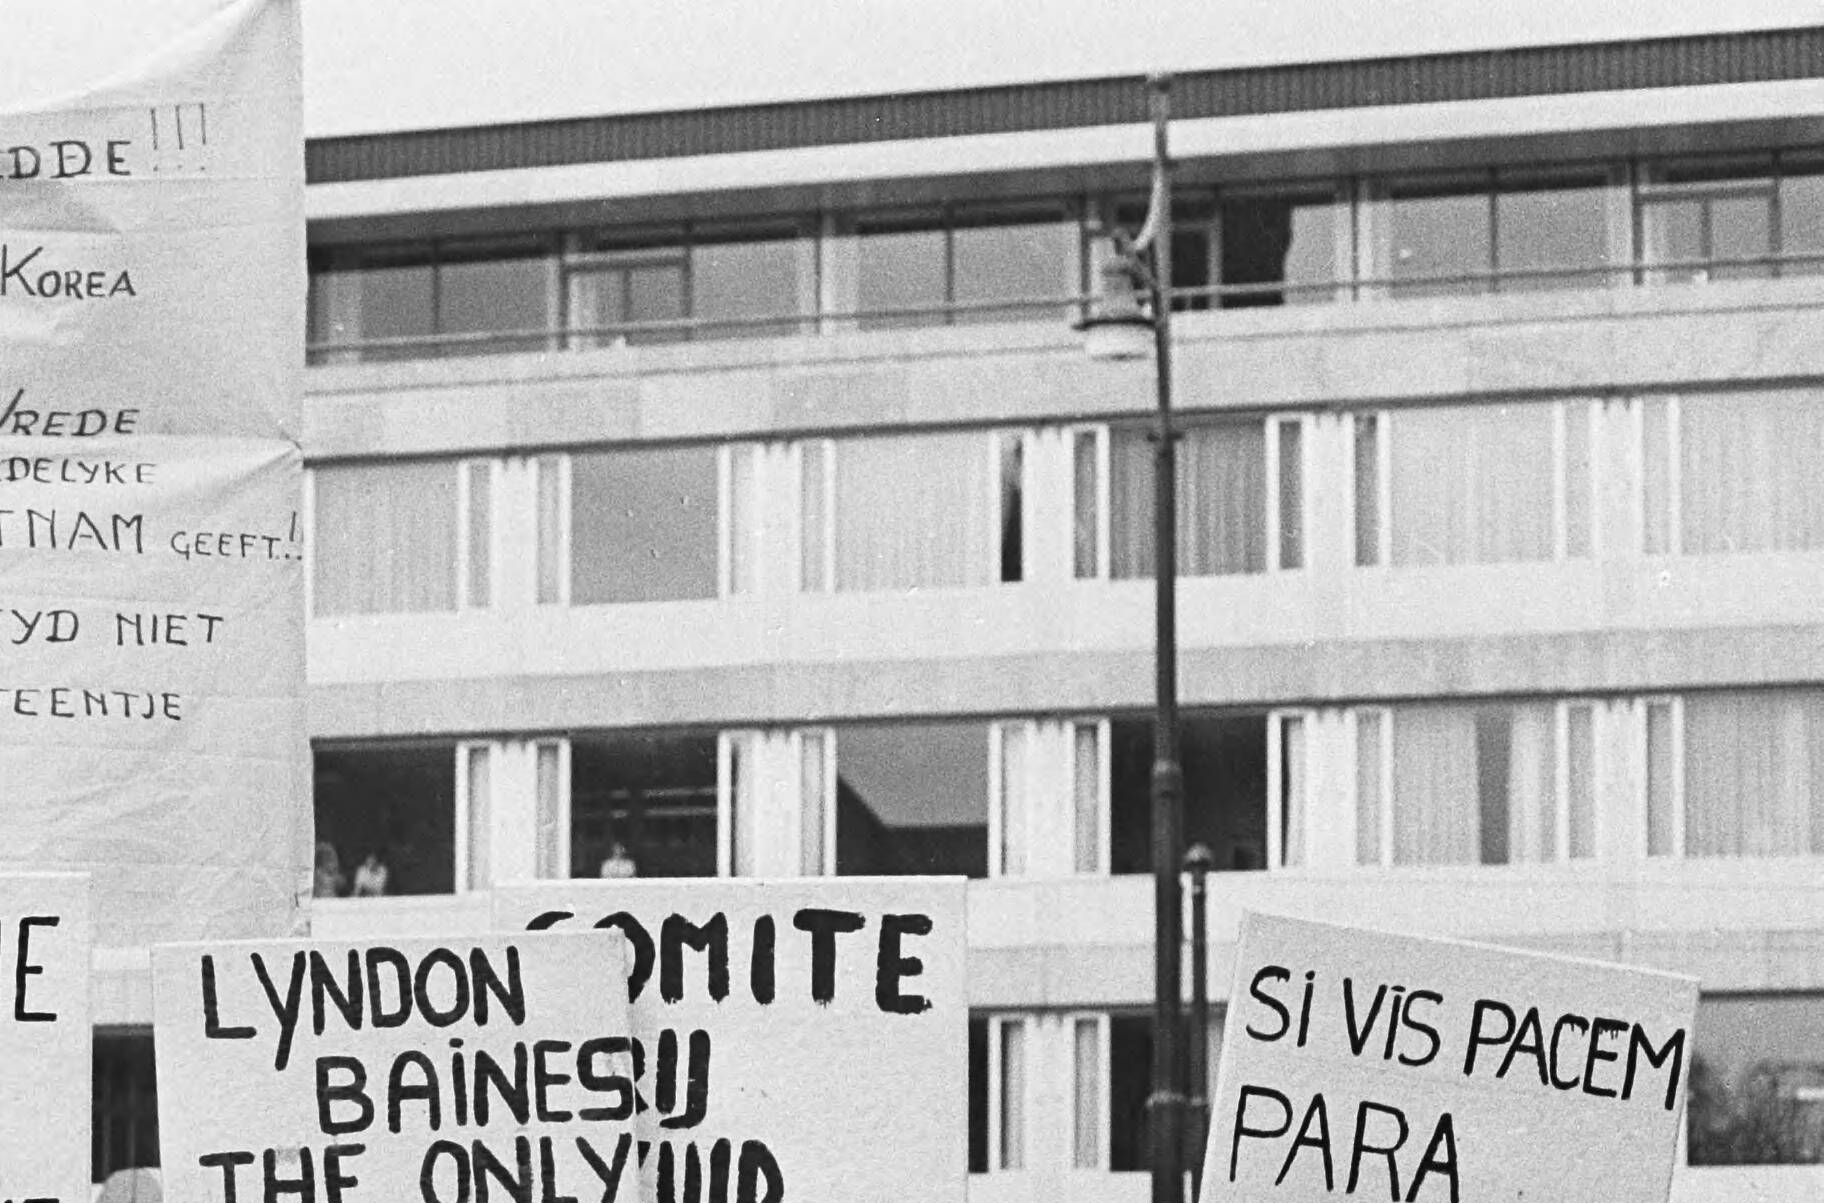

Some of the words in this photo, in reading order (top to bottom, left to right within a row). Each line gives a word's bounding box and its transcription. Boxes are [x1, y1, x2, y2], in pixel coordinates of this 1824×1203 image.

[0, 244, 137, 300] KOREA
[115, 612, 224, 646] NIET
[201, 945, 526, 1072] LYNDON
[1463, 999, 1685, 1111] PACEM
